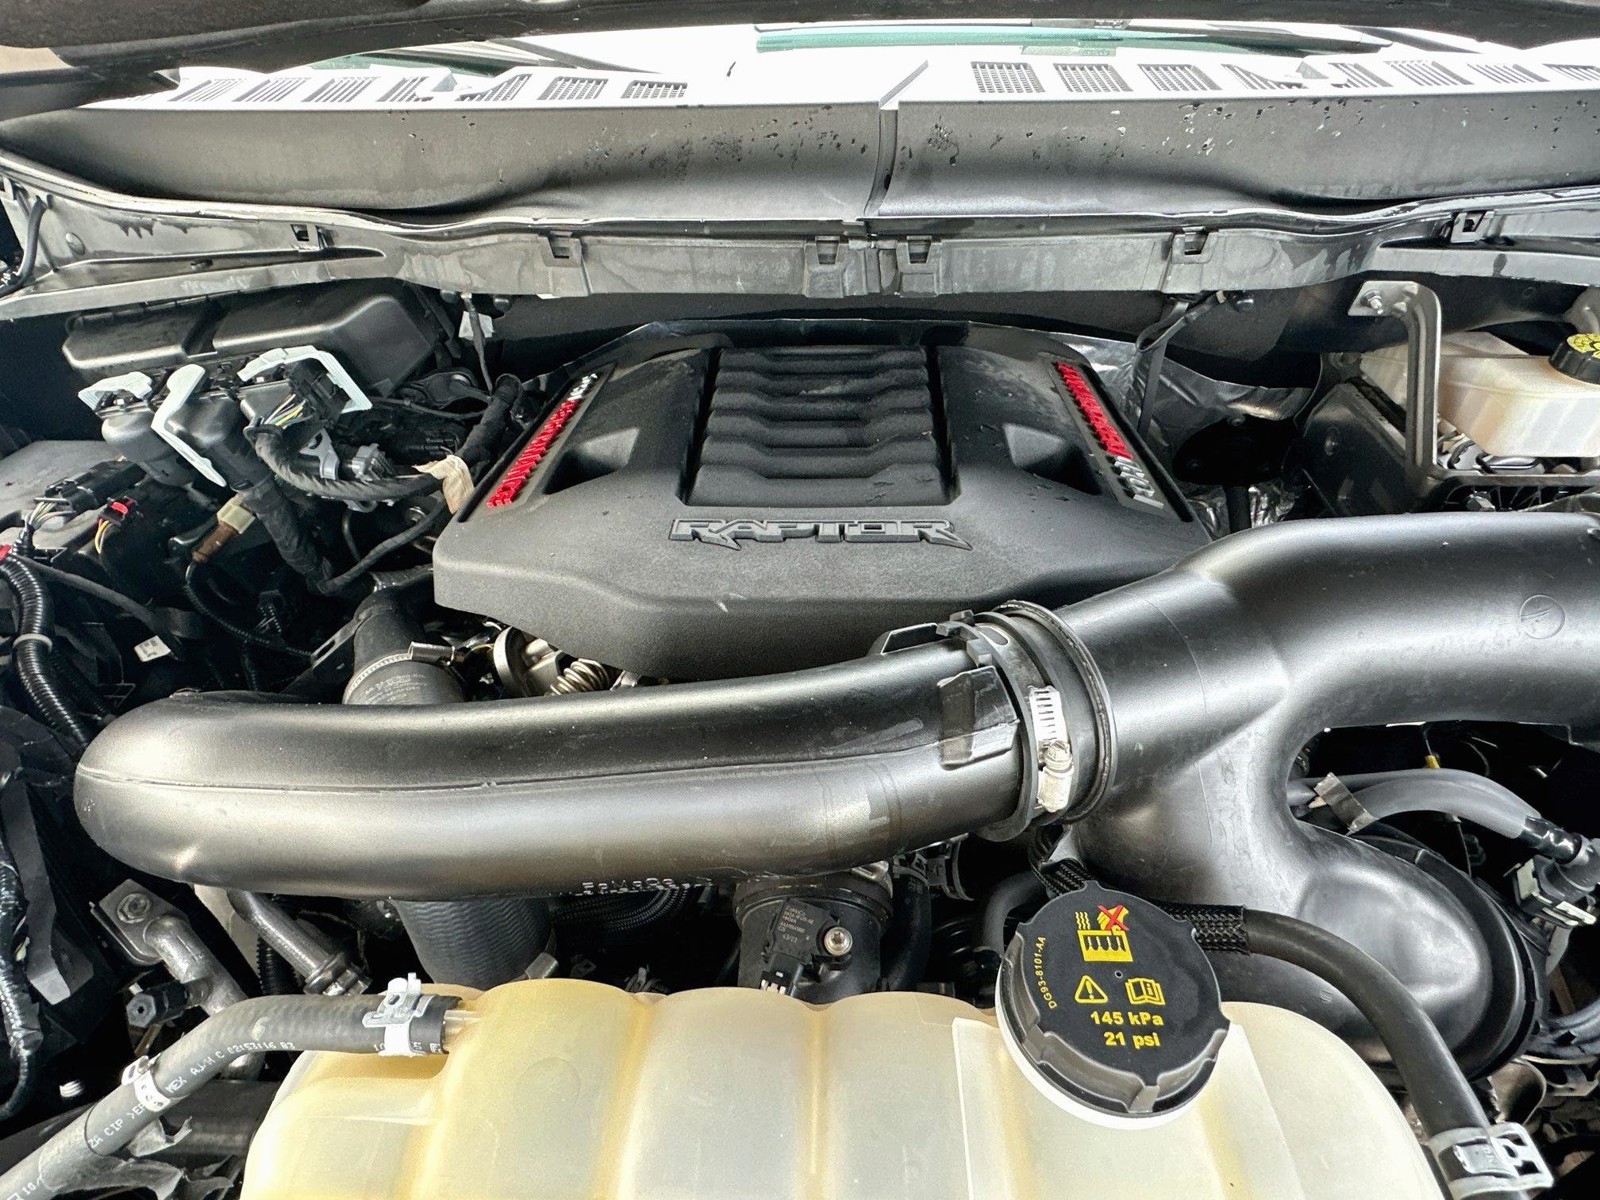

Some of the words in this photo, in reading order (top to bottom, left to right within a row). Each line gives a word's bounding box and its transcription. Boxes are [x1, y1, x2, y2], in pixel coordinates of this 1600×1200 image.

[669, 518, 973, 550] RAPTOR
[1034, 936, 1057, 1009] DG93-8101-AA
[1090, 1011, 1124, 1025] 145
[1127, 1011, 1164, 1026] kPa
[1104, 1031, 1126, 1046] 21
[1132, 1032, 1160, 1050] psi
[104, 1118, 125, 1137] CIP
